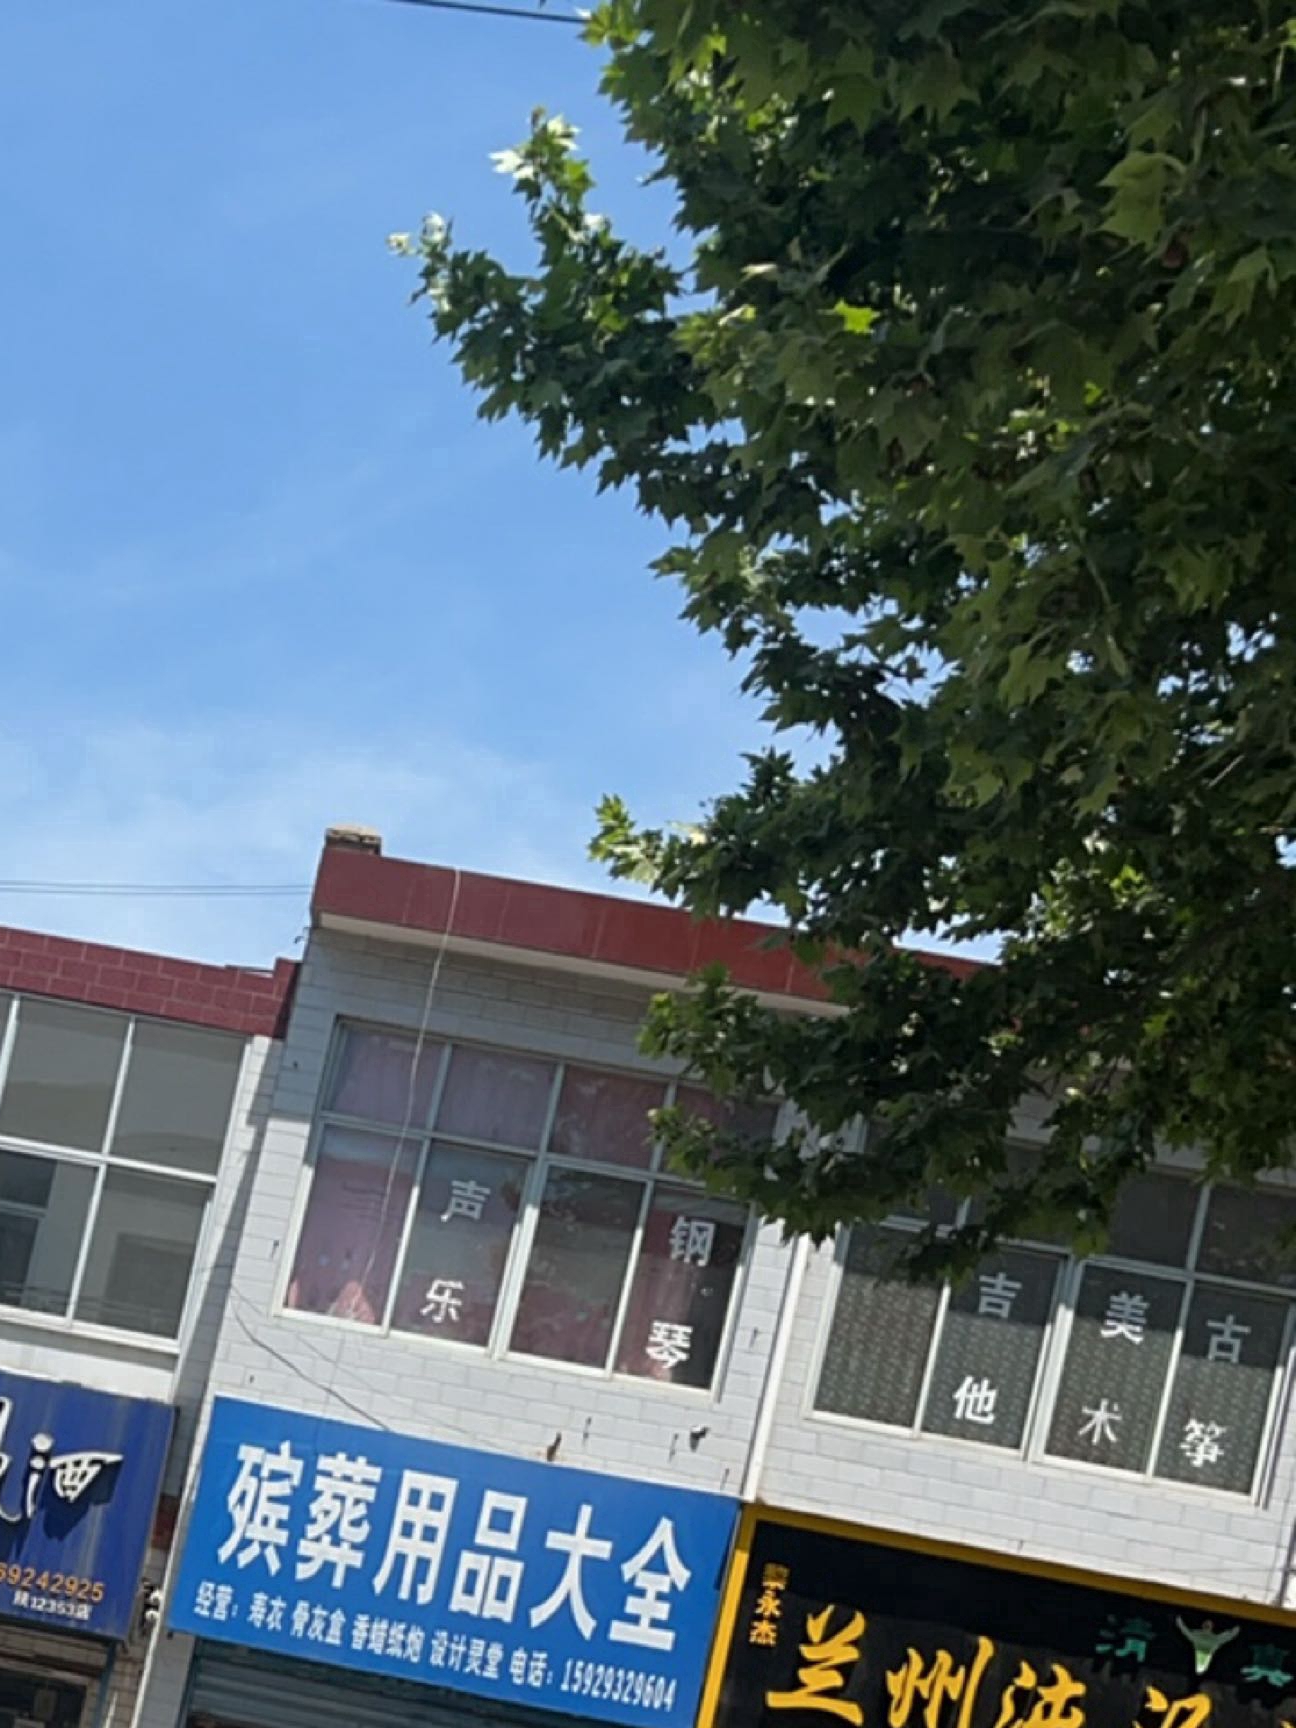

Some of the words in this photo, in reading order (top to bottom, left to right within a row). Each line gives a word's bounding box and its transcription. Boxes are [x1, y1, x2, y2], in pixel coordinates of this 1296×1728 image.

[420, 1180, 491, 1324] 声乐
[646, 1216, 715, 1369] 钢琴
[953, 1272, 1022, 1425] 吉他
[1079, 1290, 1150, 1445] 美术
[1179, 1313, 1251, 1467] 古筝
[217, 1440, 692, 1652] 殡葬用品大全
